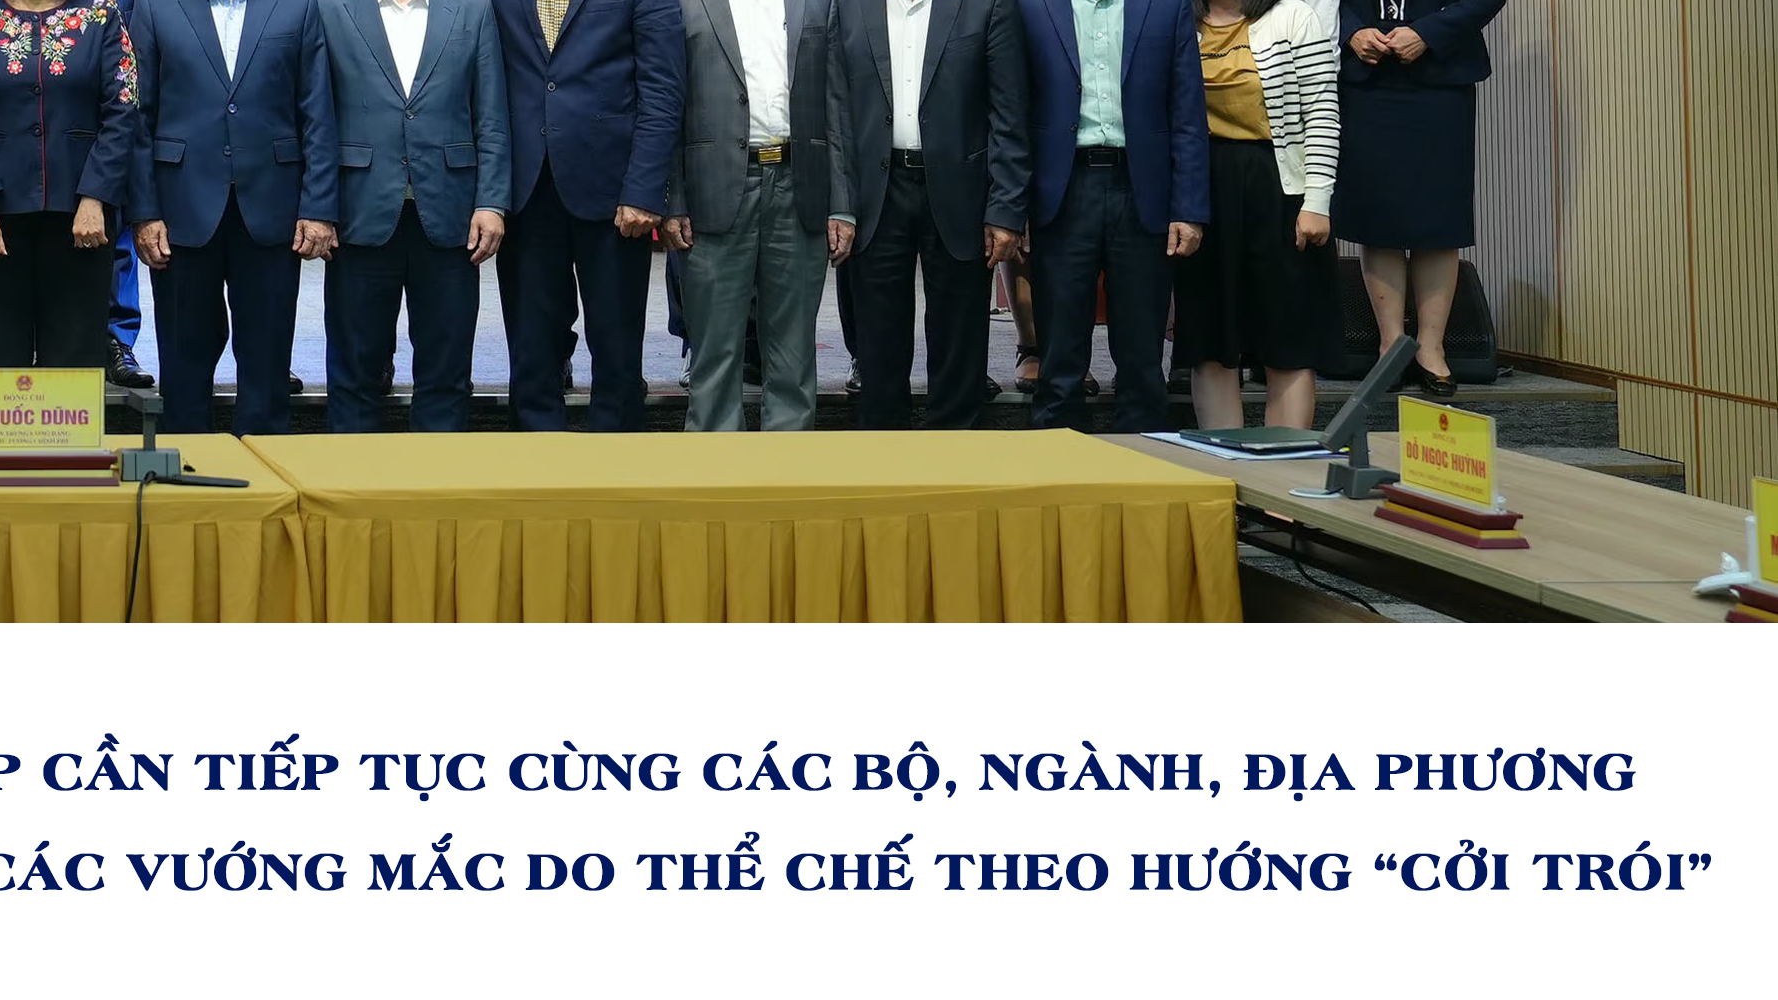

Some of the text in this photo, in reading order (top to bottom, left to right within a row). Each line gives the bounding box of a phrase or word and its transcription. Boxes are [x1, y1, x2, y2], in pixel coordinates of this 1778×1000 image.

[41, 405, 89, 426] DŨNG
[1422, 445, 1449, 471] NGỌC
[1451, 452, 1487, 479] HUỲNH
